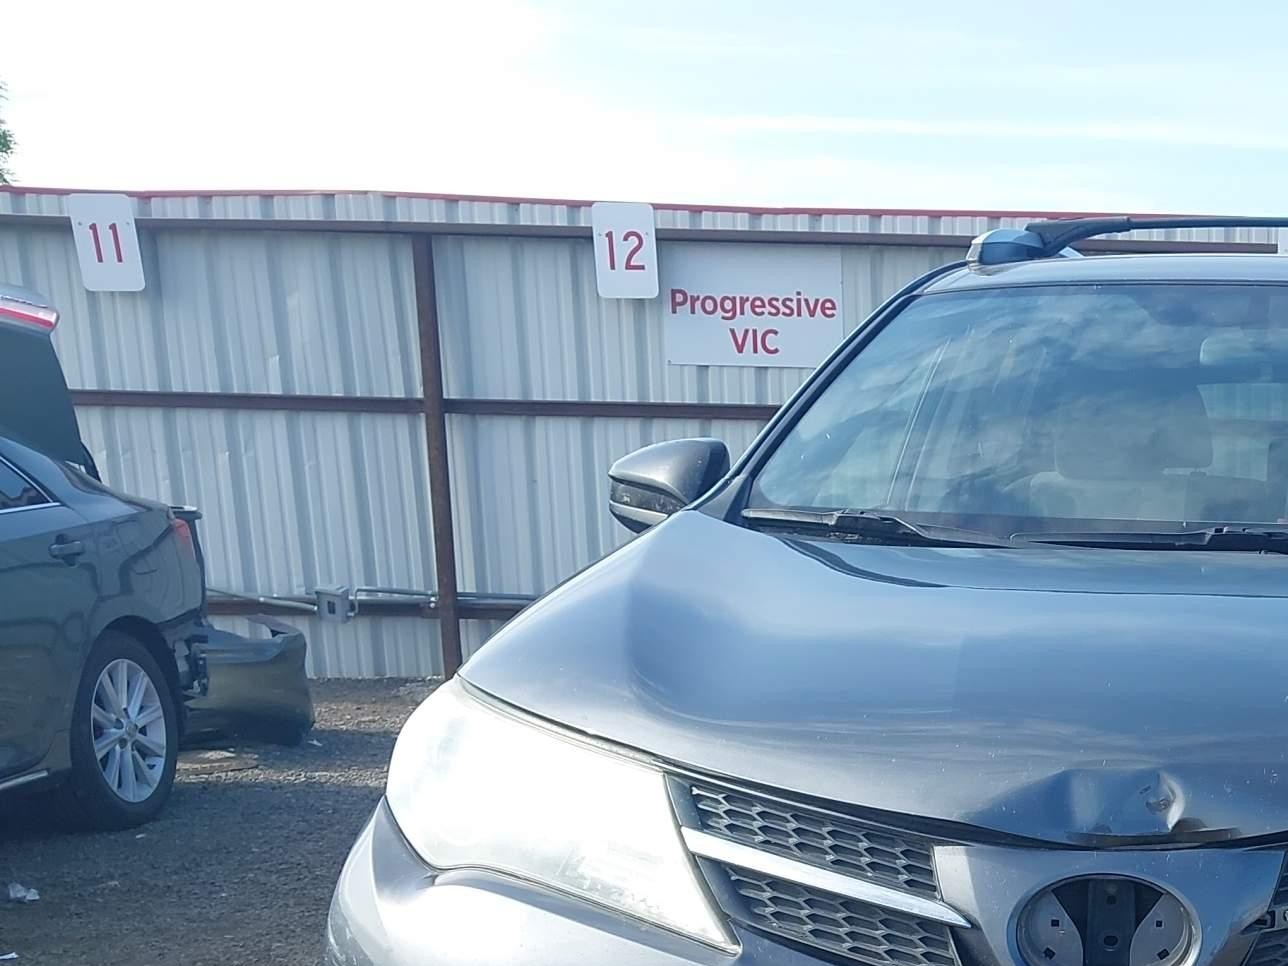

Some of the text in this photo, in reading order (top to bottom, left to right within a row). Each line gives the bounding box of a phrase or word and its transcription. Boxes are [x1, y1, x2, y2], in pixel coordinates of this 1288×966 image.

[88, 222, 123, 263] 11
[604, 230, 646, 271] 12
[670, 288, 837, 321] Progressive
[729, 328, 780, 355] VIC
